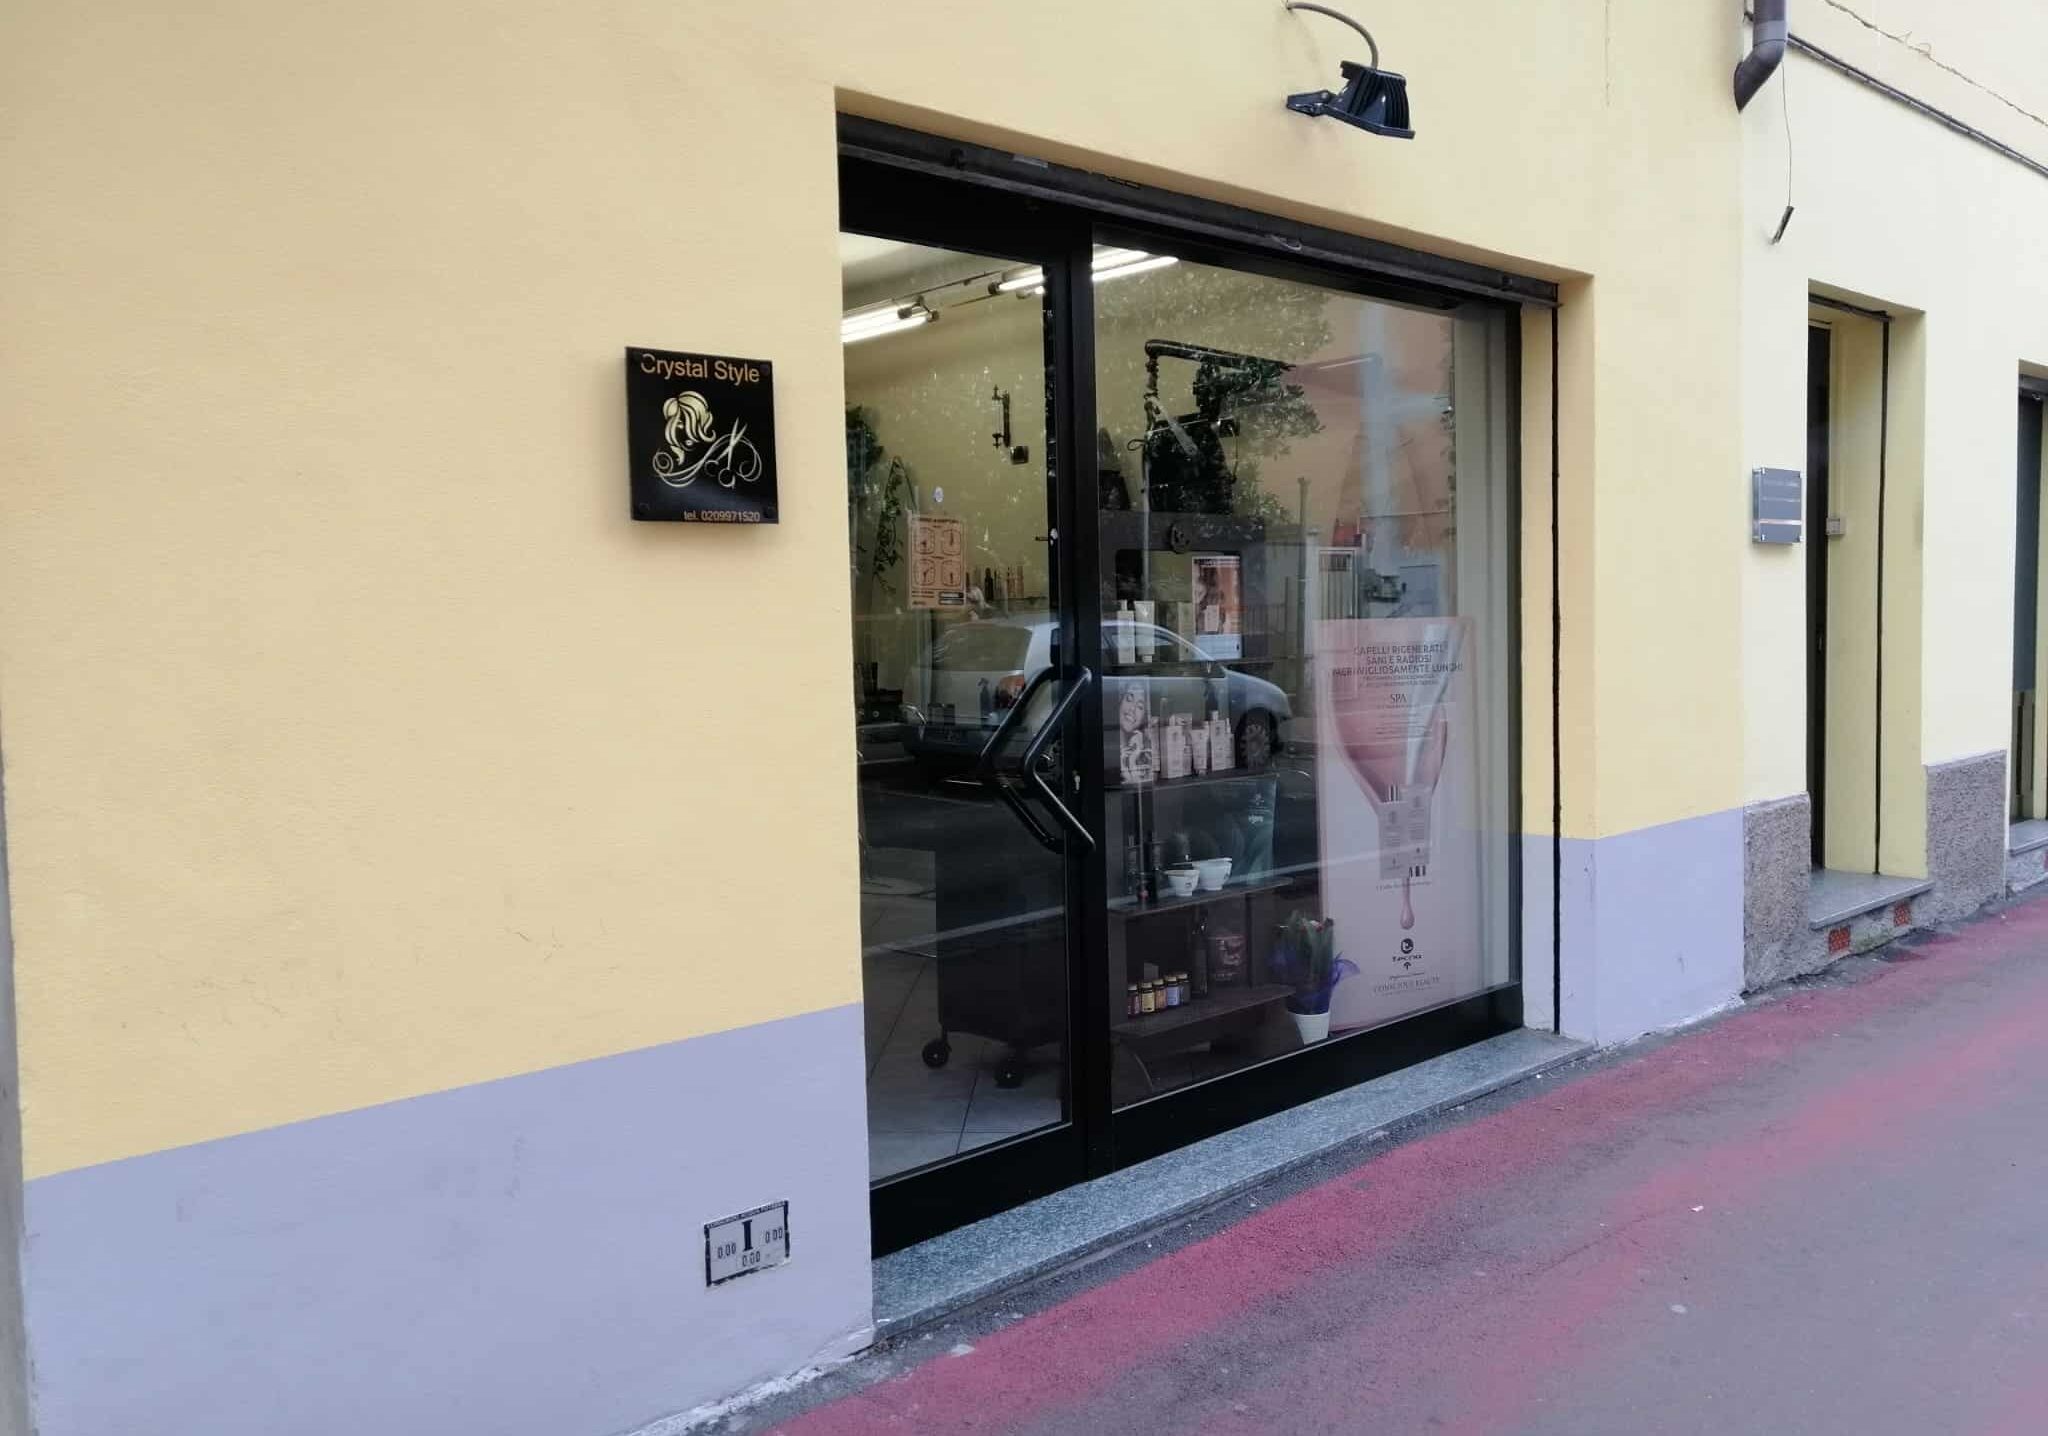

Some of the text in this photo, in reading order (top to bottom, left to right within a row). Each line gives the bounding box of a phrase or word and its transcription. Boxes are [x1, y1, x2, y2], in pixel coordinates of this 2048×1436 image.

[640, 353, 760, 386] Crystal Style
[683, 510, 761, 522] tel. 0209971520
[1353, 645, 1390, 656] CAPELLI
[1367, 655, 1387, 665] SANI
[1396, 653, 1432, 665] RADIOSI
[1390, 693, 1407, 704] SPA
